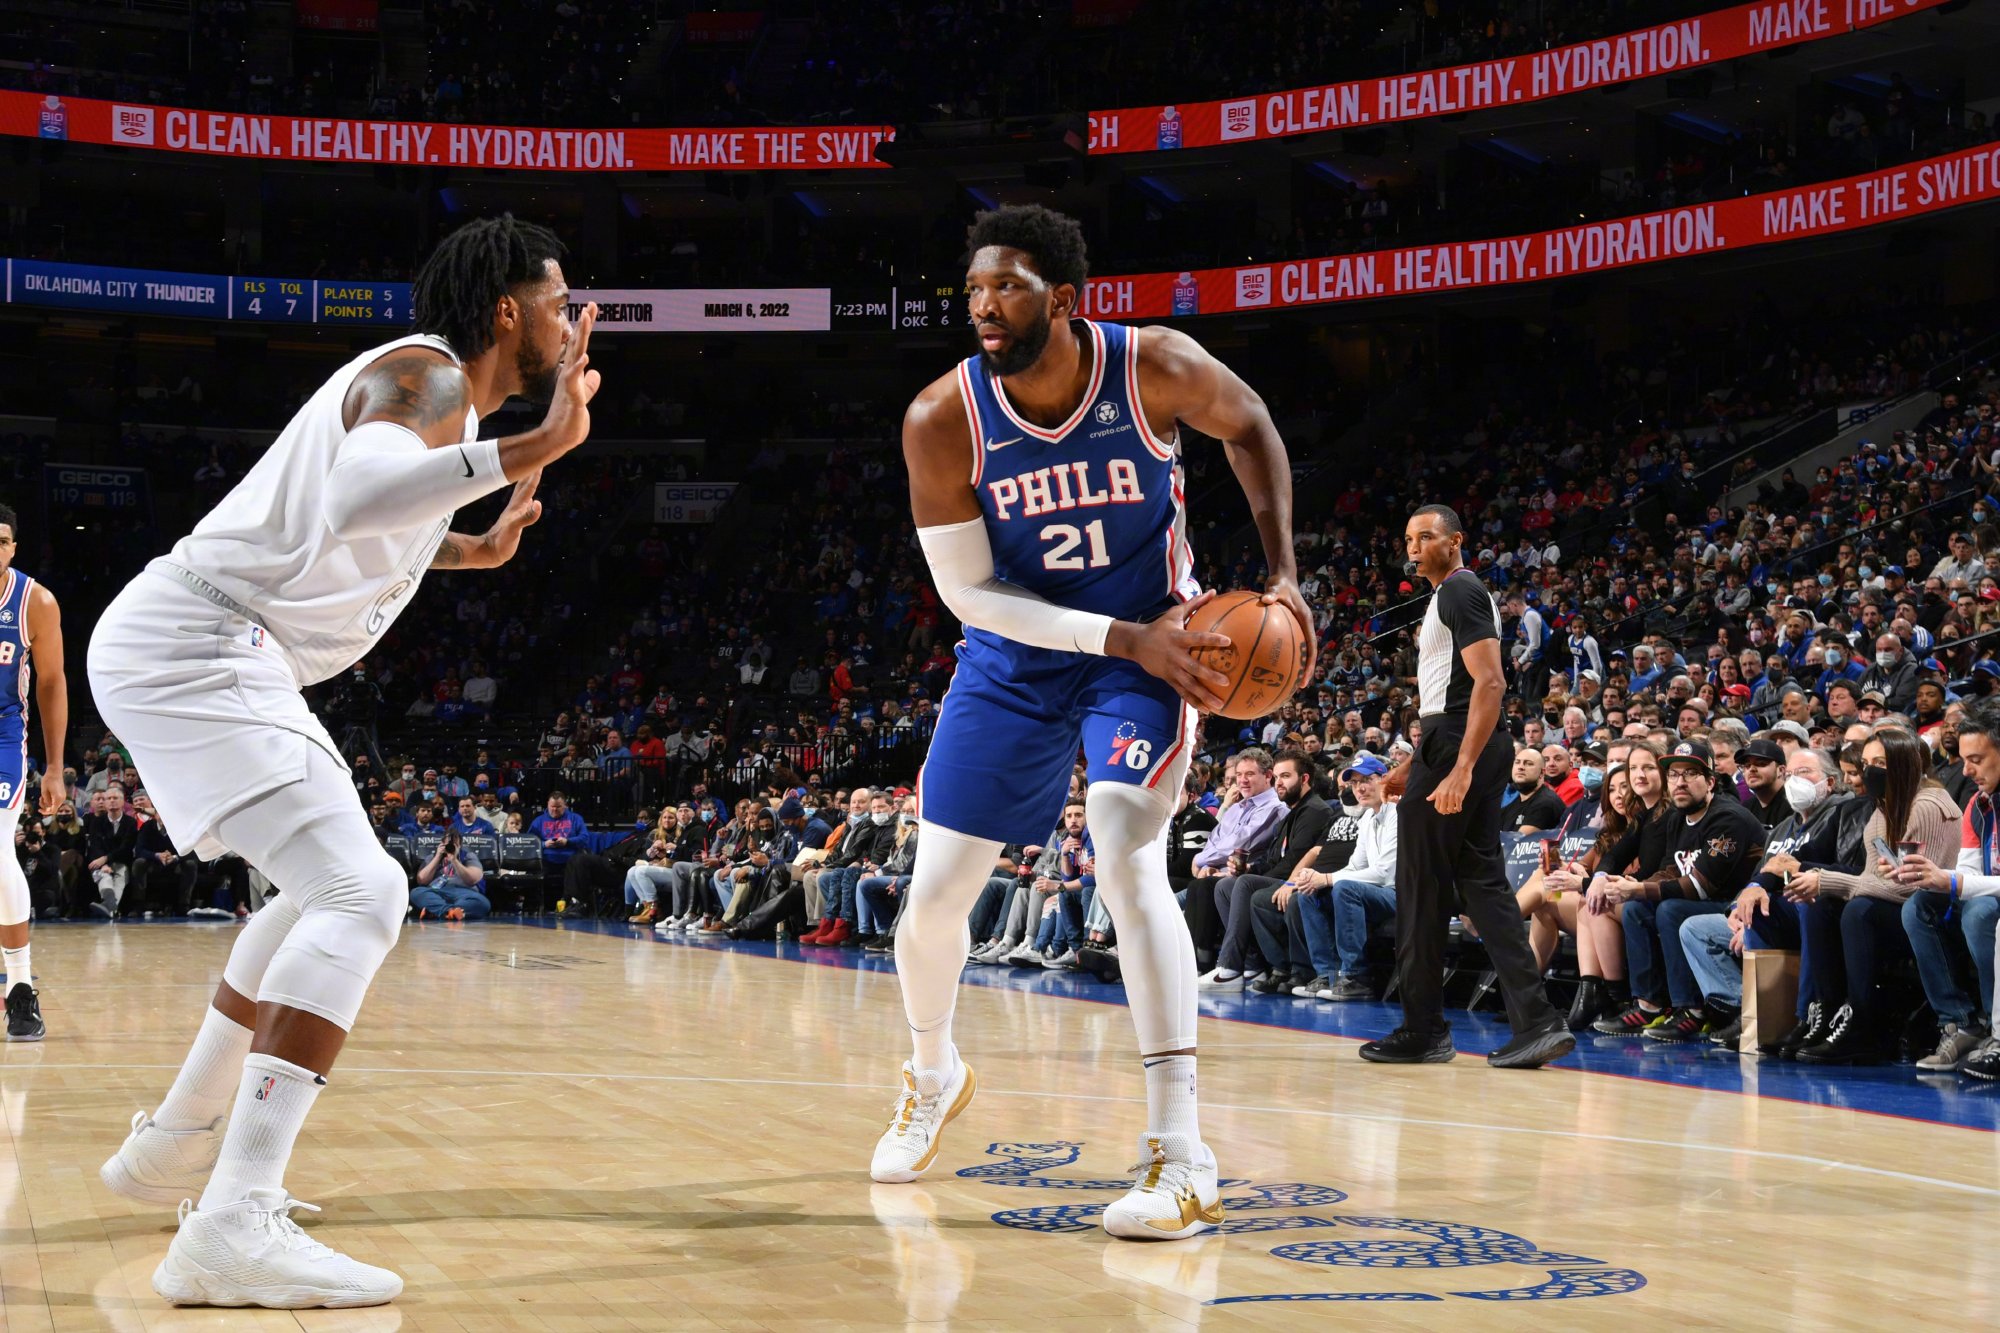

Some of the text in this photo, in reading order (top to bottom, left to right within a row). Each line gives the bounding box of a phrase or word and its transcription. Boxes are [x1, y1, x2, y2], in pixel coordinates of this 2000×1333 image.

[1749, 0, 1830, 46] MAKE
[1265, 20, 1710, 135] CLEAN. HEALTHY. HYDRATION.
[41, 111, 63, 122] BIO
[120, 111, 146, 122] BIO
[1228, 106, 1250, 118] BIO
[1161, 122, 1179, 131] BIO
[166, 110, 634, 168] CLEAN. HEALTHY. HYDRATION.
[669, 134, 745, 165] MAKE
[754, 133, 806, 164] THE
[1763, 186, 1846, 237] MAKE
[1856, 172, 1908, 219] THE
[1281, 206, 1725, 303] CLEAN. HEALTHY. HYDRATION.
[1242, 274, 1264, 284] BIO
[25, 274, 215, 303] OKLAHOMA CITY THUNDER
[244, 282, 303, 295] FLS TOL
[324, 287, 393, 301] PLAYER 5
[936, 287, 953, 296] REB
[1175, 288, 1194, 297] BIO
[1074, 281, 1133, 315] TCH
[248, 298, 297, 315] 4 7
[324, 305, 373, 318] POINTS
[384, 307, 394, 319] 4
[596, 303, 653, 322] CREATOR
[704, 303, 790, 318] MARCH 6, 2022
[834, 304, 887, 316] 7:23 PM
[904, 299, 950, 313] PHI 9
[901, 315, 929, 328] OKC
[941, 315, 950, 326] 6
[1089, 424, 1132, 439] crypto.com
[58, 470, 131, 487] GEICO
[52, 487, 137, 507] 119 118
[666, 488, 730, 501] GEICO
[988, 459, 1145, 520] PHILA
[661, 505, 683, 520] 118
[1039, 519, 1110, 570] 21
[1107, 737, 1152, 770] 76
[418, 837, 435, 845] NJM
[462, 836, 479, 844] NJM
[506, 837, 523, 845] NJM
[1561, 837, 1581, 854] NJM
[1511, 841, 1534, 859] NJM
